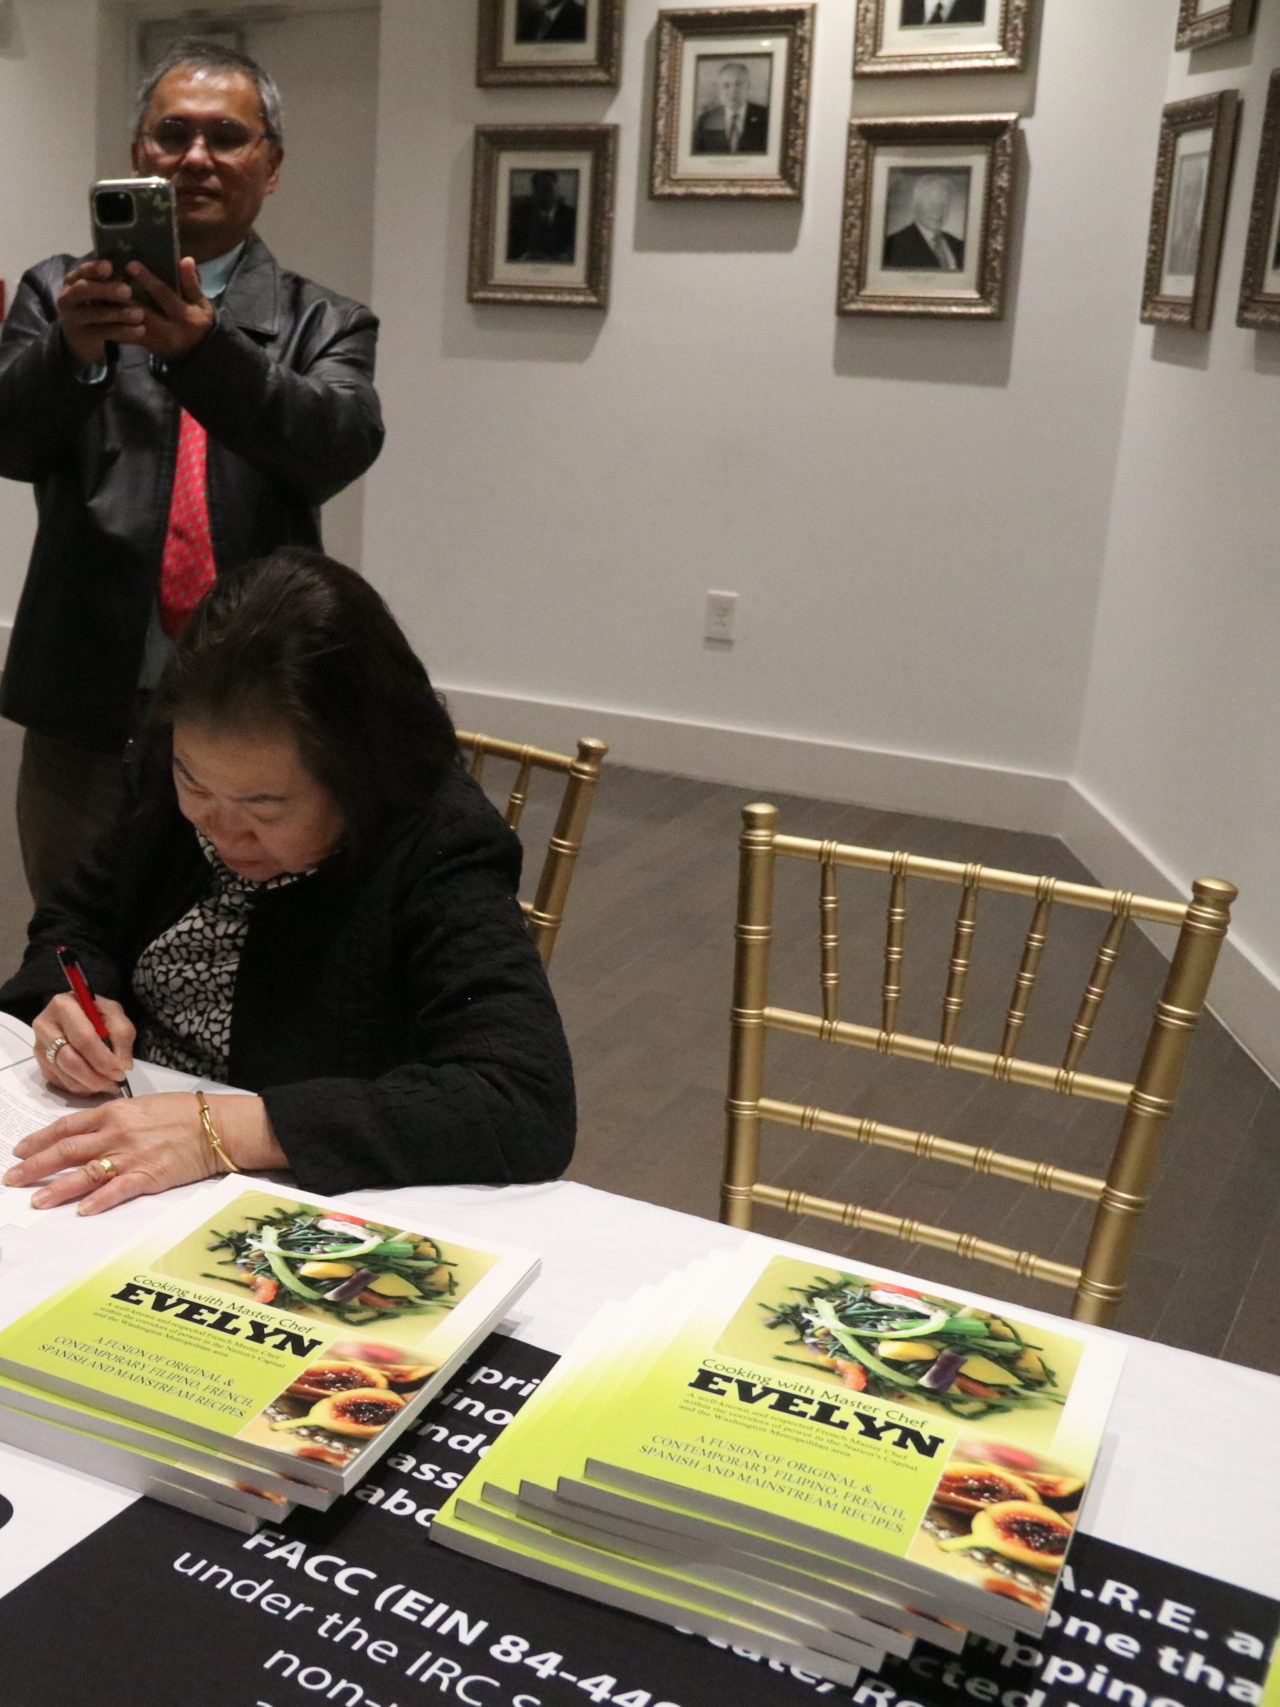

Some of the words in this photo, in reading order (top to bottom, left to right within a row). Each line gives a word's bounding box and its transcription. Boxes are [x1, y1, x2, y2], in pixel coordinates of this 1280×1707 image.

[110, 1282, 323, 1358] EVELYN
[133, 1275, 189, 1298] Cooking
[193, 1293, 224, 1307] with
[227, 1302, 276, 1322] Master
[279, 1318, 315, 1334] Chef
[38, 1344, 89, 1365] SPANISH
[88, 1360, 115, 1374] AND
[113, 1369, 196, 1401] MAINSTREAM
[54, 1336, 147, 1371] CONTEMPORARY
[96, 1335, 104, 1344] A
[105, 1339, 146, 1357] FUSION
[148, 1353, 167, 1363] OF
[165, 1359, 222, 1383] ORIGINAL
[436, 1387, 514, 1426] ino
[688, 1368, 945, 1459] EVELYN
[702, 1358, 772, 1386] Cooking
[778, 1379, 815, 1395] with
[820, 1390, 880, 1413] Master
[885, 1409, 928, 1429] Chef
[639, 1444, 700, 1469] SPANISH
[702, 1464, 735, 1479] AND
[737, 1472, 839, 1512] MAINSTREAM
[652, 1434, 771, 1475] CONTEMPORARY
[843, 1490, 906, 1521] FRENCH,
[695, 1434, 706, 1444] A
[709, 1437, 761, 1459] FUSION
[765, 1453, 786, 1465] OF
[786, 1460, 858, 1489] ORIGINAL
[862, 1484, 873, 1494] &
[172, 1552, 315, 1621] under
[317, 1612, 399, 1665] the
[405, 1651, 501, 1707] IRC
[242, 1528, 377, 1596] FACC
[374, 1583, 489, 1647] (EIN
[489, 1634, 683, 1707] 84-44
[263, 1649, 399, 1707] non-
